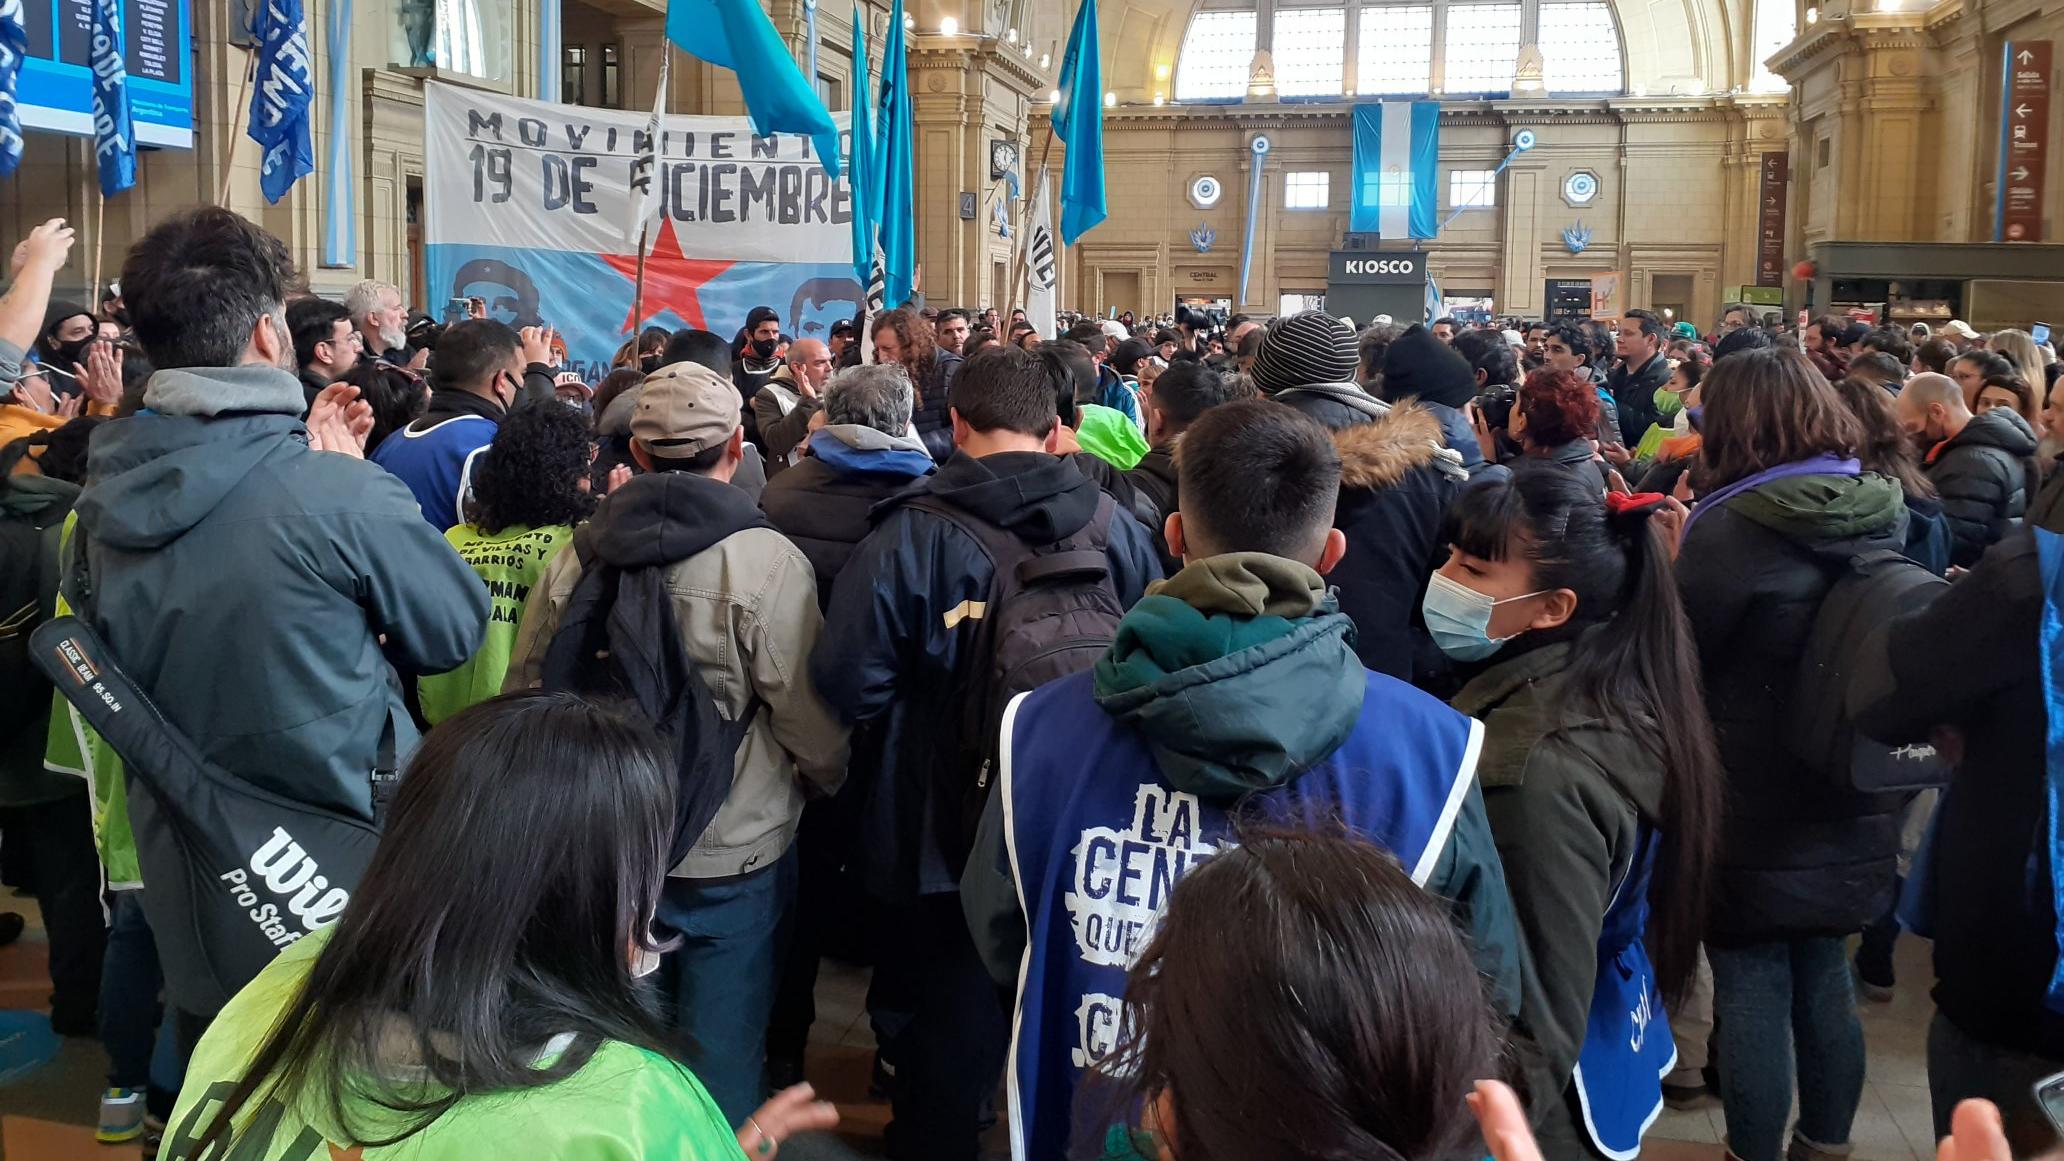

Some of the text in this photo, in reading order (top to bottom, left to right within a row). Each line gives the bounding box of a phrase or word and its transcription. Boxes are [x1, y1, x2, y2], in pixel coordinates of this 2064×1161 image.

[469, 144, 852, 225] 19 DE ICIEMBRE
[962, 195, 972, 215] 4
[1345, 260, 1414, 275] KIOSCO
[482, 543, 532, 555] VILLAS
[537, 547, 547, 561] Y
[60, 640, 95, 682] CLASSIC BEAM
[1140, 792, 1192, 851] LA
[220, 868, 258, 908] Pro
